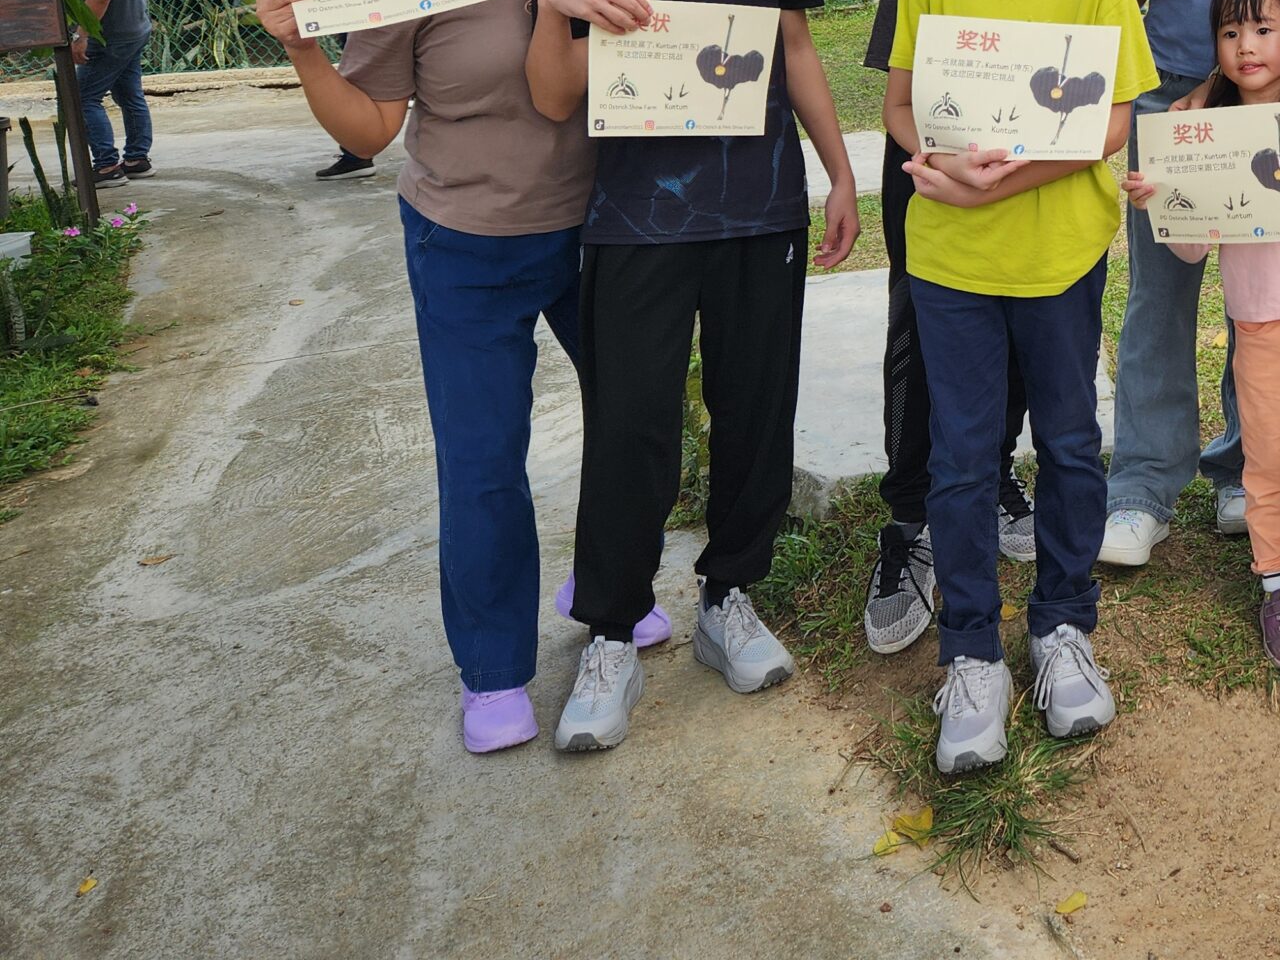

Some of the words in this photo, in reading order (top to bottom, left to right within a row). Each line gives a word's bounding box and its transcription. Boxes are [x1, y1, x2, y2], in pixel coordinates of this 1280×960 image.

[956, 29, 1000, 52] 奖状
[991, 125, 1018, 134] Kuntum
[1173, 122, 1215, 144] 奖状
